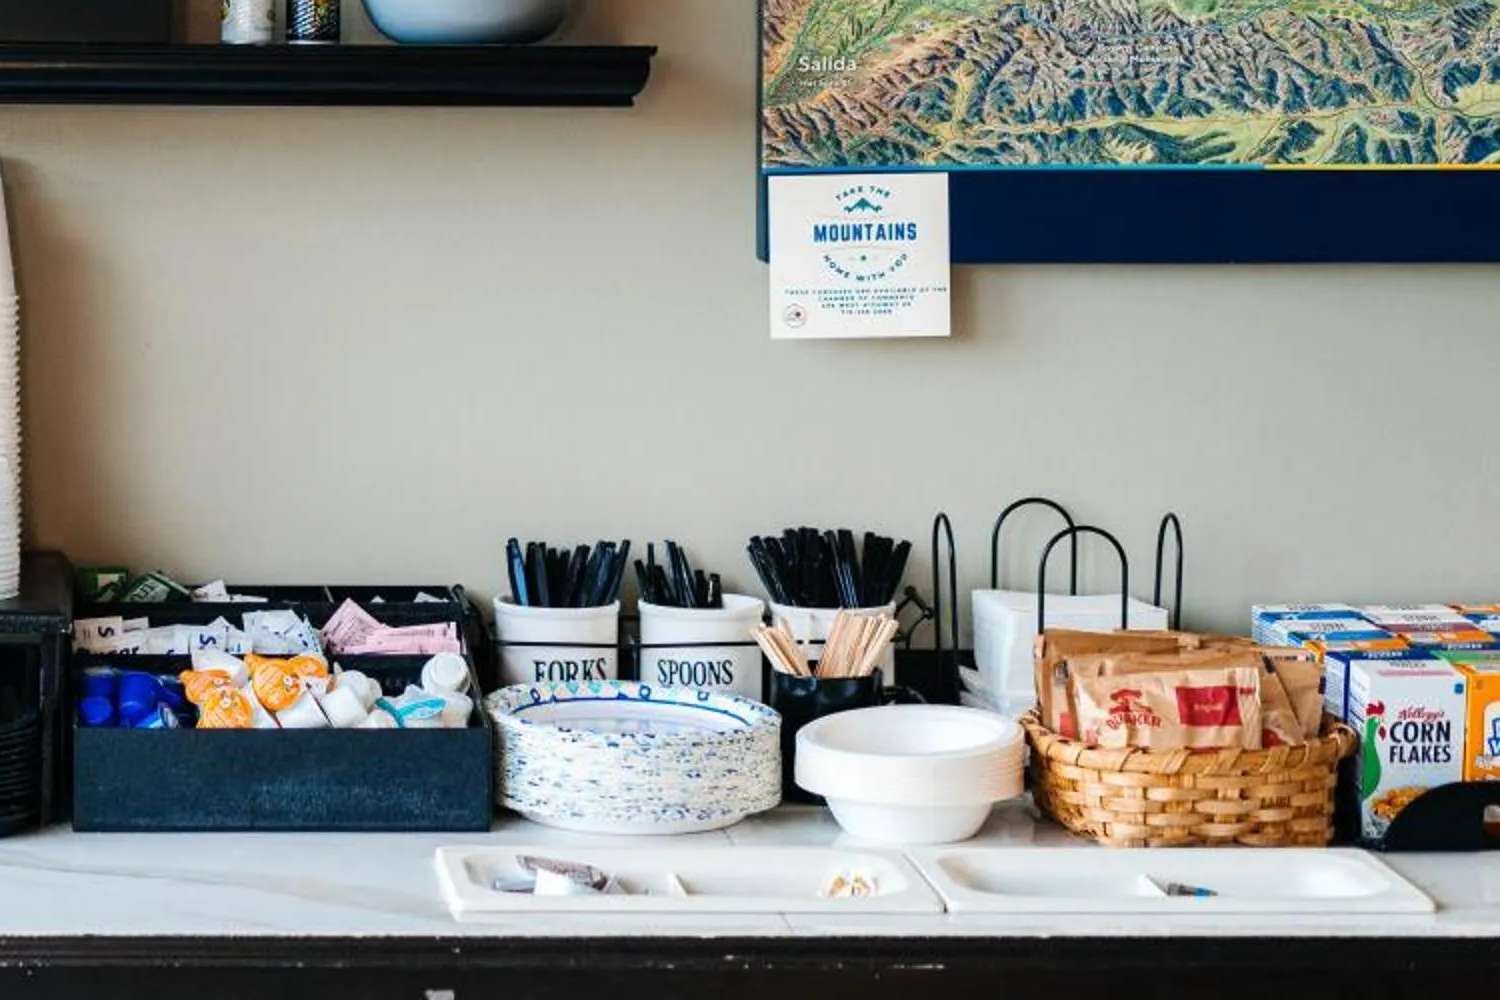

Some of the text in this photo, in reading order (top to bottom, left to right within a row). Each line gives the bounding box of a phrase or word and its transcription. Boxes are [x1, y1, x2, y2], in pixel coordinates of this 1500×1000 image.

[797, 55, 857, 72] Salida
[835, 185, 891, 201] TAKE THE
[813, 222, 917, 242] MOUNTAINS
[824, 254, 851, 279] HOME
[855, 271, 886, 281] WITH
[532, 657, 733, 687] FORKS SPOONS
[1398, 706, 1445, 722] Kellogg's
[1390, 720, 1451, 743] CORN
[1390, 745, 1451, 764] FLAKES
